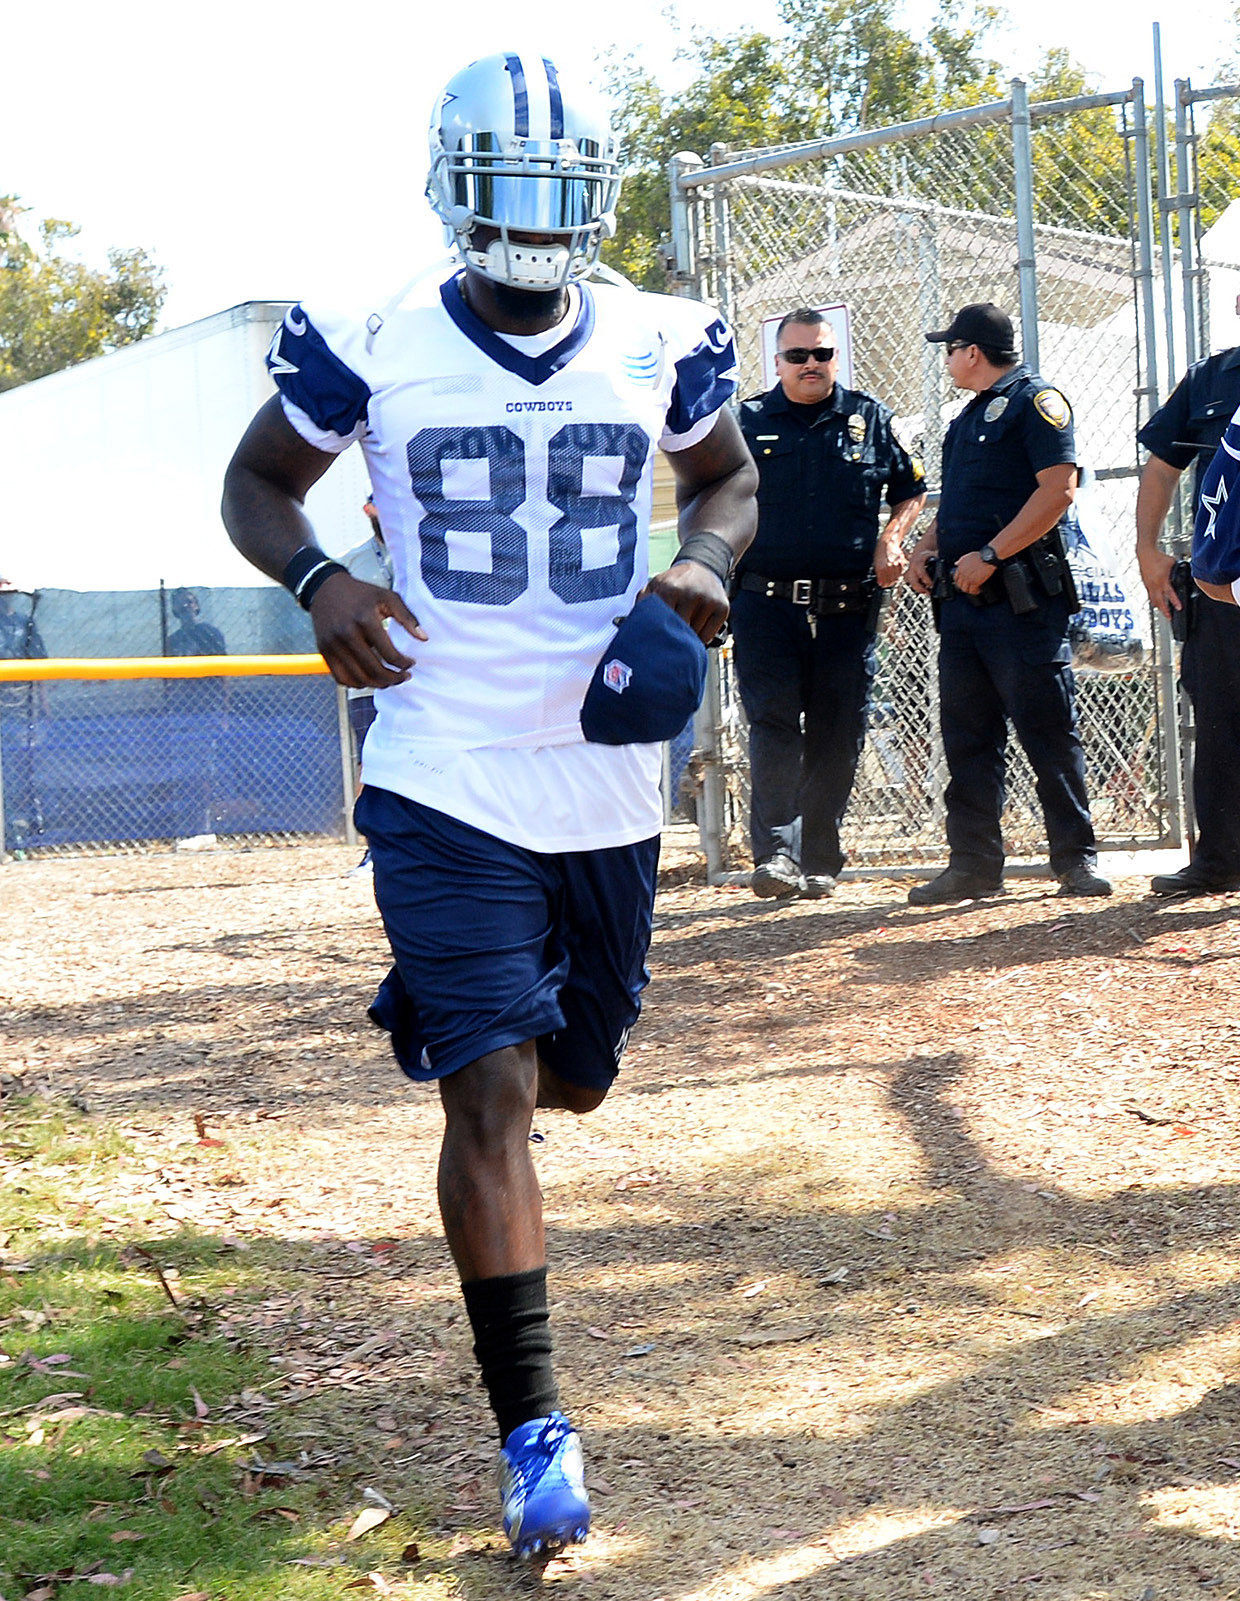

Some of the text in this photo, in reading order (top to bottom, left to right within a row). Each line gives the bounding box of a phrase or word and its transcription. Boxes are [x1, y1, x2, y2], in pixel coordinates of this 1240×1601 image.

[505, 401, 573, 413] COWBOYS
[406, 423, 650, 606] 88
[1079, 581, 1125, 603] LLAS
[1070, 608, 1134, 630] BOYS
